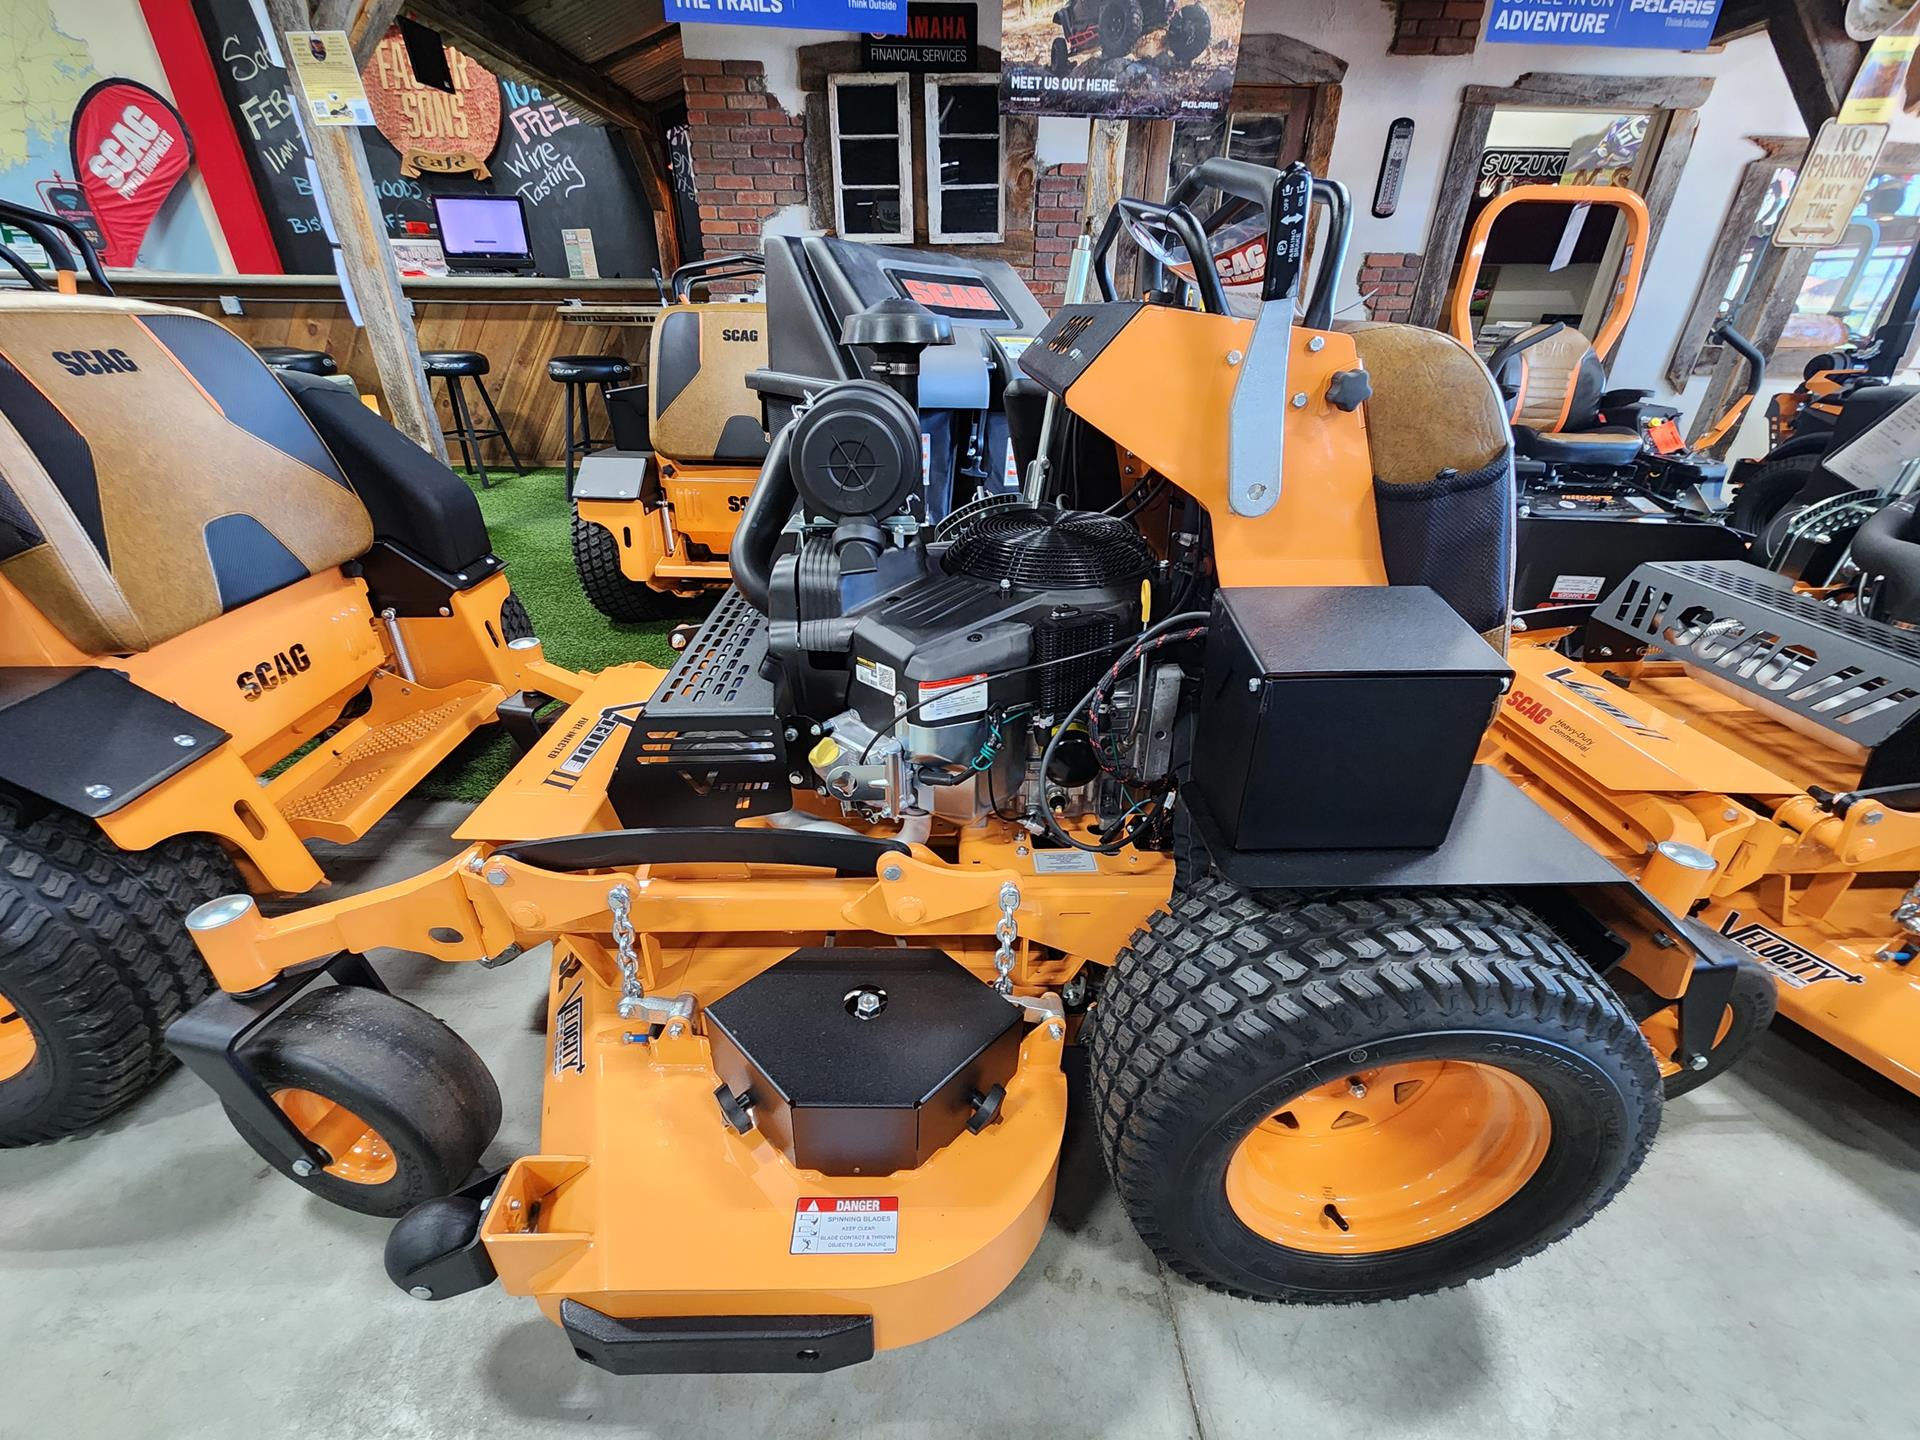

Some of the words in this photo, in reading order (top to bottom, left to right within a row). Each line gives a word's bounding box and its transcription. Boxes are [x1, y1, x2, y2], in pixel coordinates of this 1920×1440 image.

[1630, 0, 1716, 15] POLARIS
[1494, 9, 1610, 34] ADVENTURE
[871, 47, 921, 62] FINANCIAL
[922, 48, 967, 63] SERVICES
[1011, 75, 1042, 90] MEET
[1044, 76, 1059, 90] US
[1061, 78, 1085, 91] OUT
[1086, 78, 1119, 92] HERE.
[401, 90, 469, 139] SONS
[1180, 100, 1219, 110] POLARIS
[509, 103, 580, 145] FREE
[88, 104, 160, 189] SCAG
[1834, 128, 1868, 152] NO
[503, 142, 561, 179] Wine
[1481, 153, 1568, 177] SUZUKI
[1807, 153, 1873, 179] PARKING
[515, 154, 586, 207] Tasting
[1813, 182, 1845, 200] ANY
[1806, 203, 1838, 220] TIME
[1287, 229, 1297, 262] PARKING
[1215, 244, 1266, 277] CAG
[904, 280, 996, 309] SCAG
[723, 329, 758, 342] SCAG
[52, 348, 138, 376] SCAG
[1661, 605, 1821, 692] SCAG
[236, 643, 311, 702] SCAG
[1506, 690, 1553, 725] SCAG
[547, 716, 589, 760] FUEL-INJECTED
[1549, 724, 1592, 753] Commercial
[1556, 718, 1594, 745] Heavy-Duty
[827, 1215, 861, 1223] SPINNING
[836, 1200, 881, 1212] DANGER
